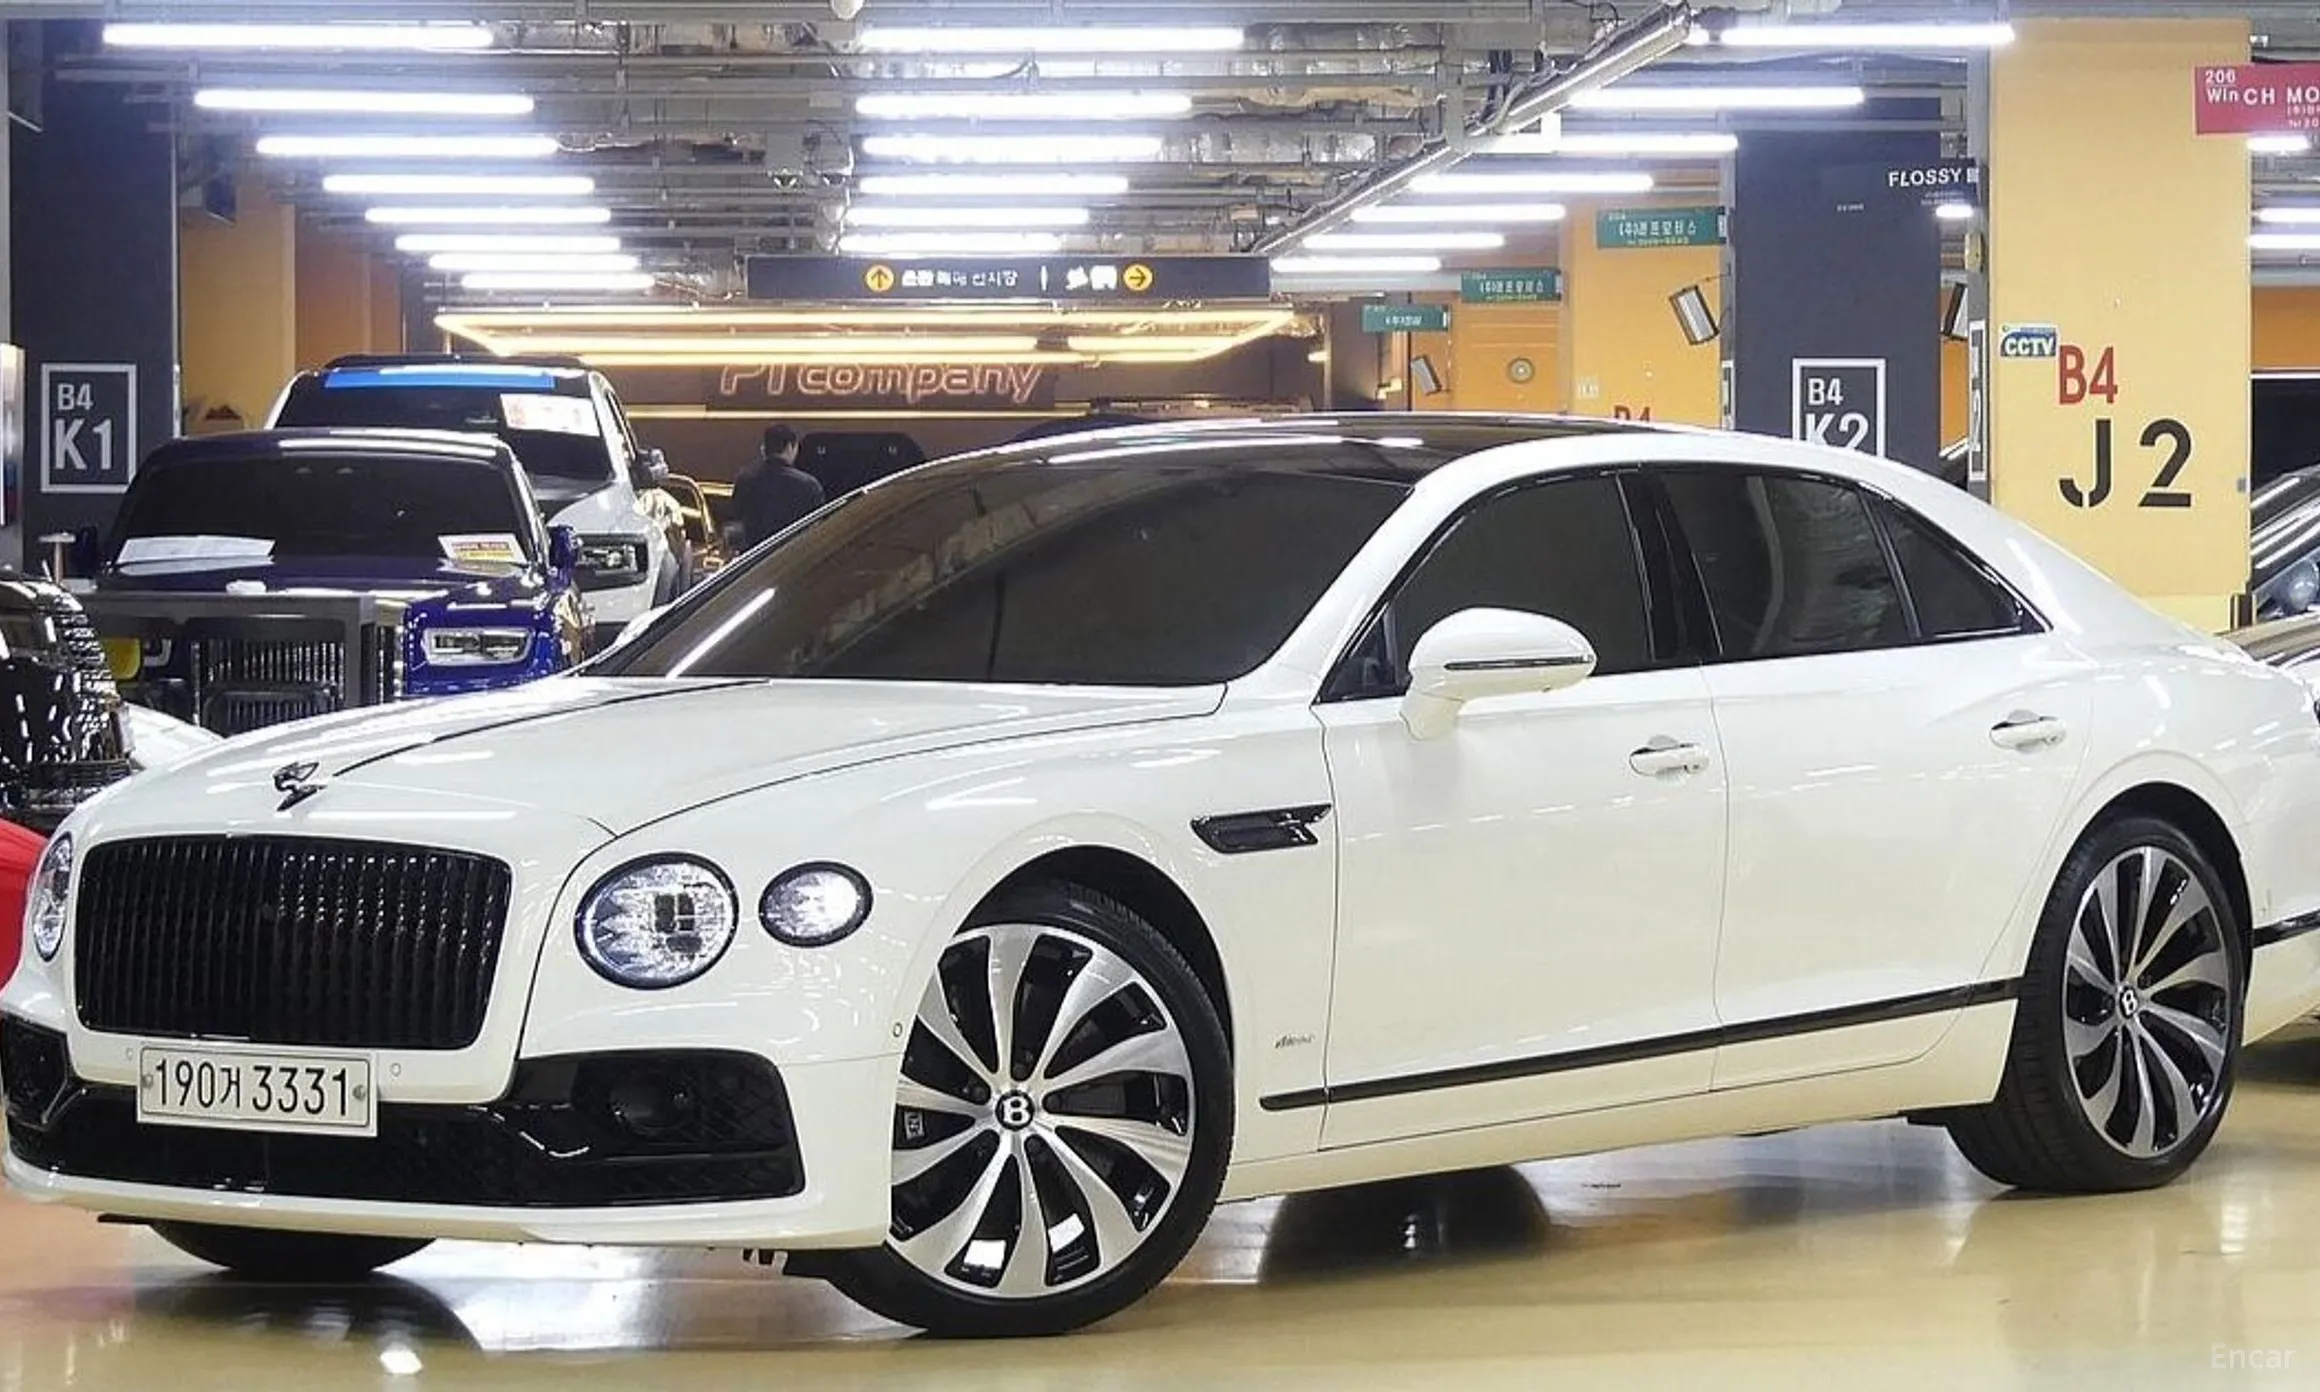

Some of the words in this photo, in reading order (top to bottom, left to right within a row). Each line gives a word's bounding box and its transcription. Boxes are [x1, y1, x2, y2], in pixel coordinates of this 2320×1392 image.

[1889, 168, 1961, 187] FLOSSY
[2004, 336, 2054, 355] CCTV
[2058, 345, 2118, 404] B4
[57, 383, 95, 410] B4
[1808, 378, 1844, 406] B4
[55, 419, 112, 470] K1
[1806, 412, 1869, 451] K2
[251, 1065, 347, 1116] 3331
[1002, 1095, 1031, 1126] B
